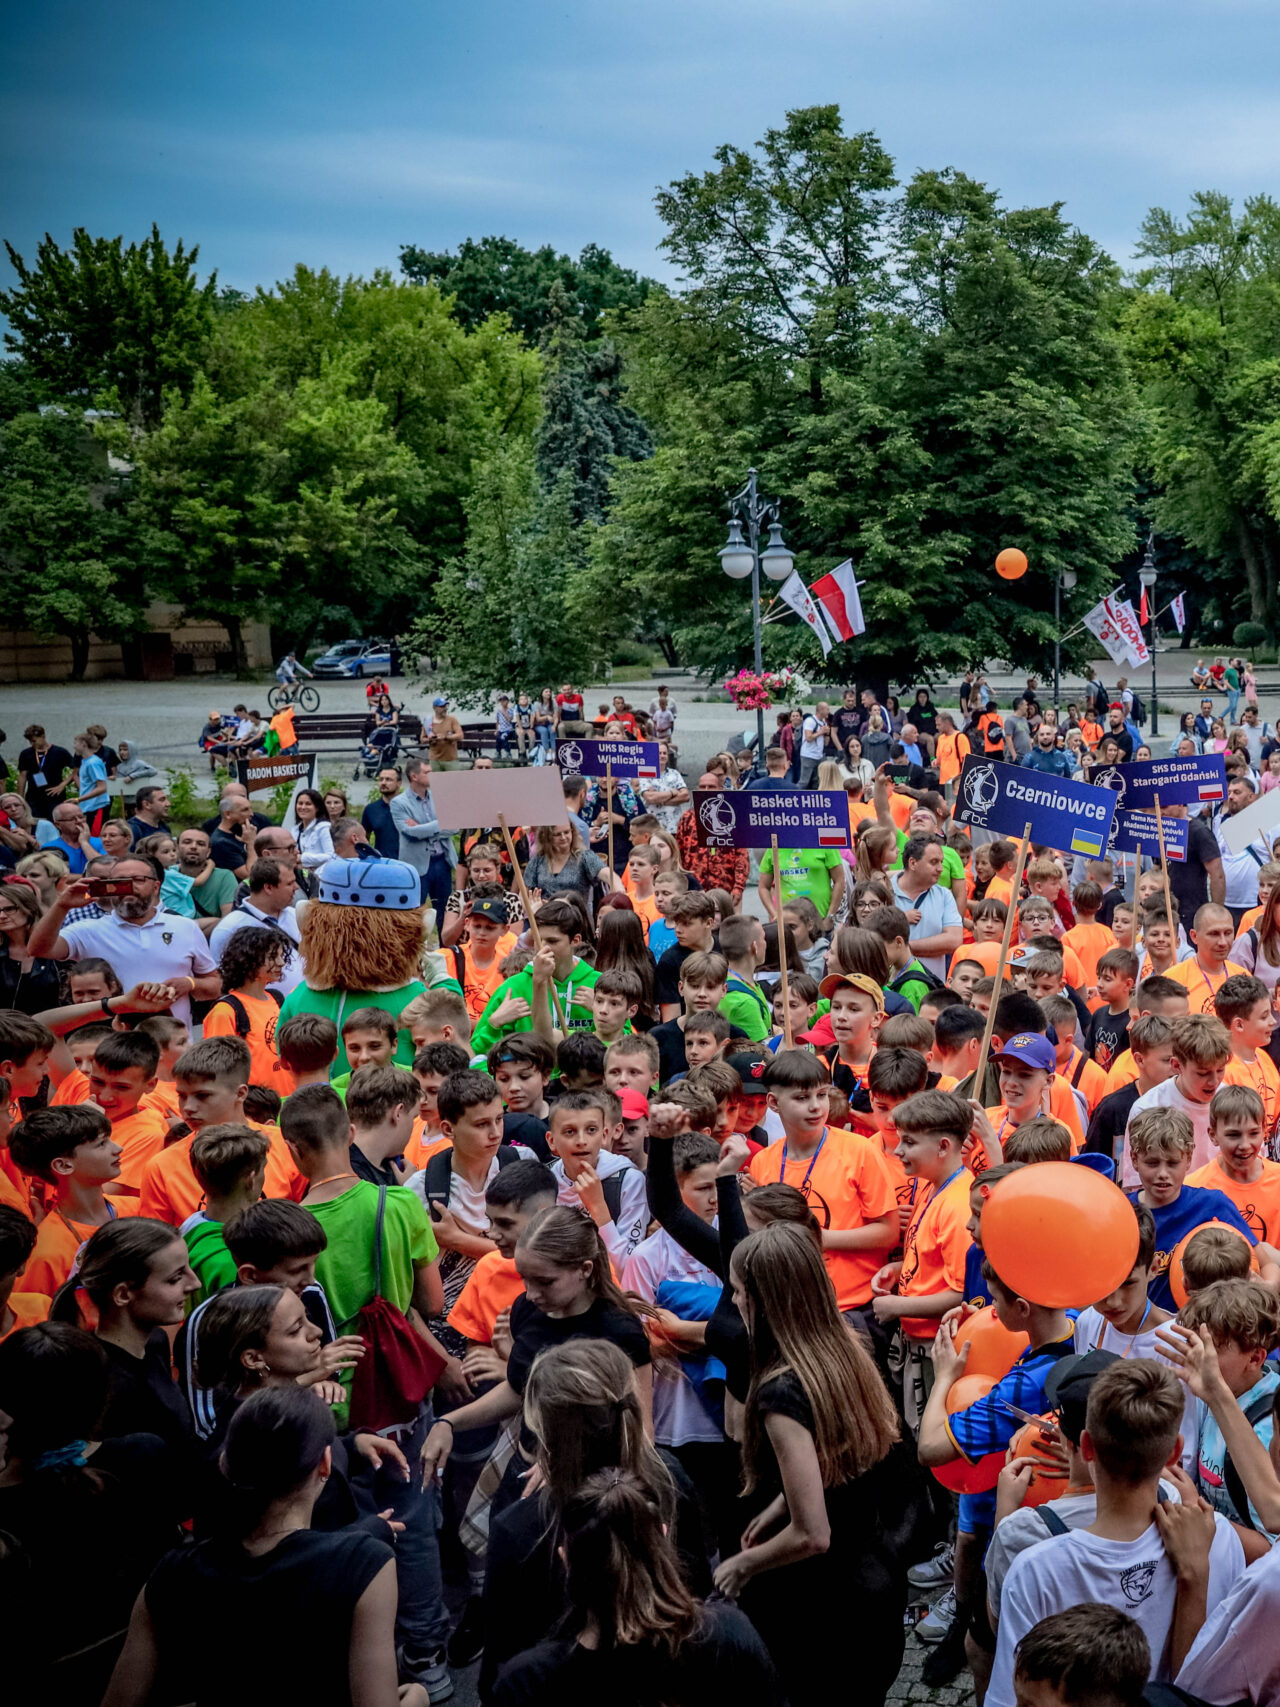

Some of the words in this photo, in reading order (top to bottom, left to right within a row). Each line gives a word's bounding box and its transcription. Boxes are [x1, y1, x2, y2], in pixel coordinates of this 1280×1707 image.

[598, 743, 617, 753] UKS
[618, 744, 643, 755] Regis
[597, 754, 645, 765] Wieliczka
[246, 766, 272, 780] RADOM
[273, 764, 298, 777] BASKET
[298, 762, 310, 774] CUP
[1152, 764, 1169, 774] SKS
[1170, 762, 1198, 772] Gama
[1133, 774, 1180, 787] Starogard
[1180, 769, 1219, 783] Gdański
[751, 794, 799, 808] Basket
[802, 794, 832, 808] Hills
[1005, 779, 1107, 821] Czerniowce
[749, 812, 800, 826] Bielsko
[802, 812, 837, 826] Biała
[1130, 814, 1147, 823] Gama
[1123, 821, 1150, 831] Akademia
[1128, 829, 1155, 840] Starogard
